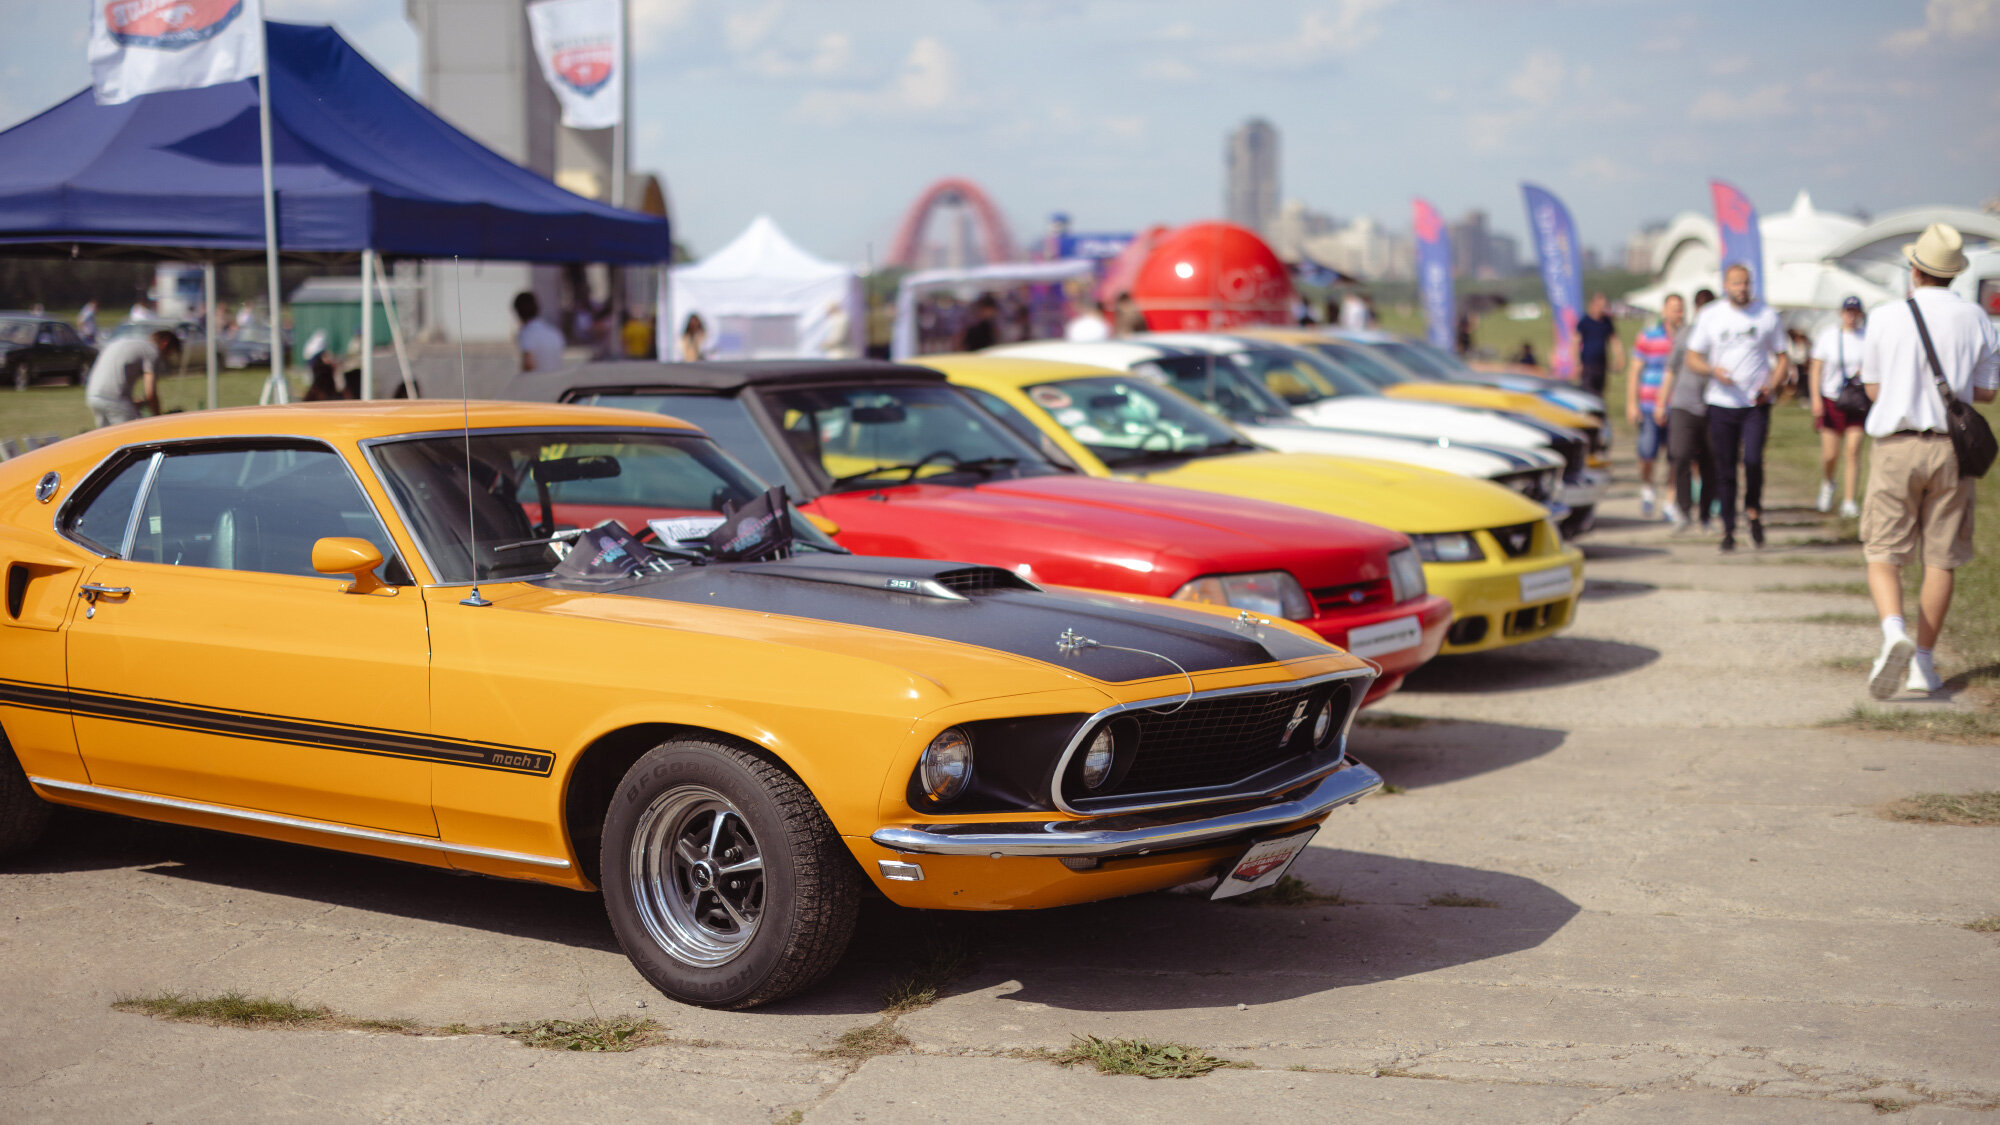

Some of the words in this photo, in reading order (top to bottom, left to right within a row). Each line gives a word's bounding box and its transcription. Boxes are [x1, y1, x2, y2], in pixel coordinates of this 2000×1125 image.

[890, 579, 912, 589] 351
[492, 753, 532, 768] mach
[533, 757, 542, 769] 1
